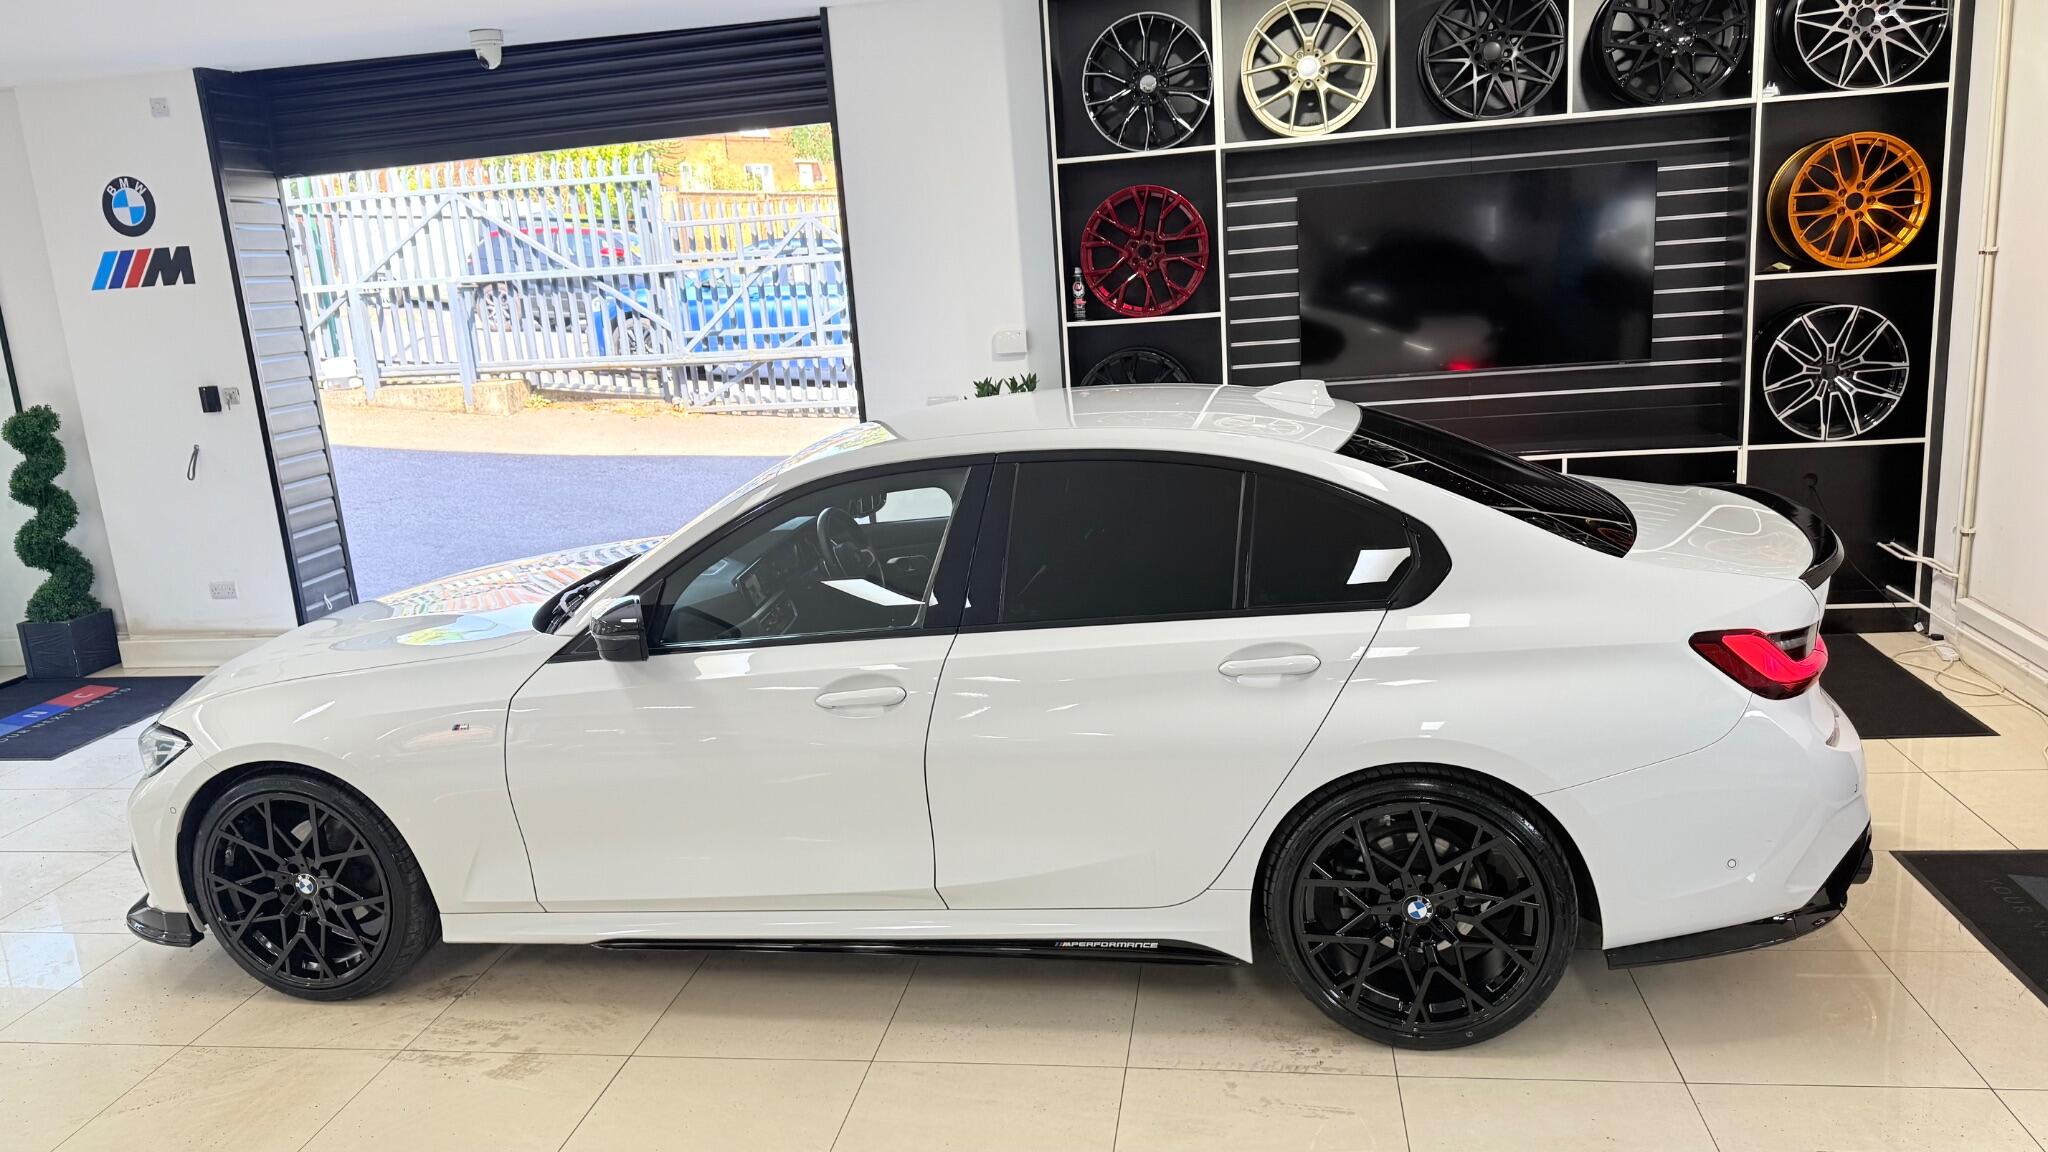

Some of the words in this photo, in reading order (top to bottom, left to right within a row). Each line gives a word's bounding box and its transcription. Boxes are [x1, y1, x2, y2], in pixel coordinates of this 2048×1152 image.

[106, 178, 147, 196] BMW
[1983, 879, 2033, 913] YOUR
[1071, 941, 1159, 949] PERFORMANCE
